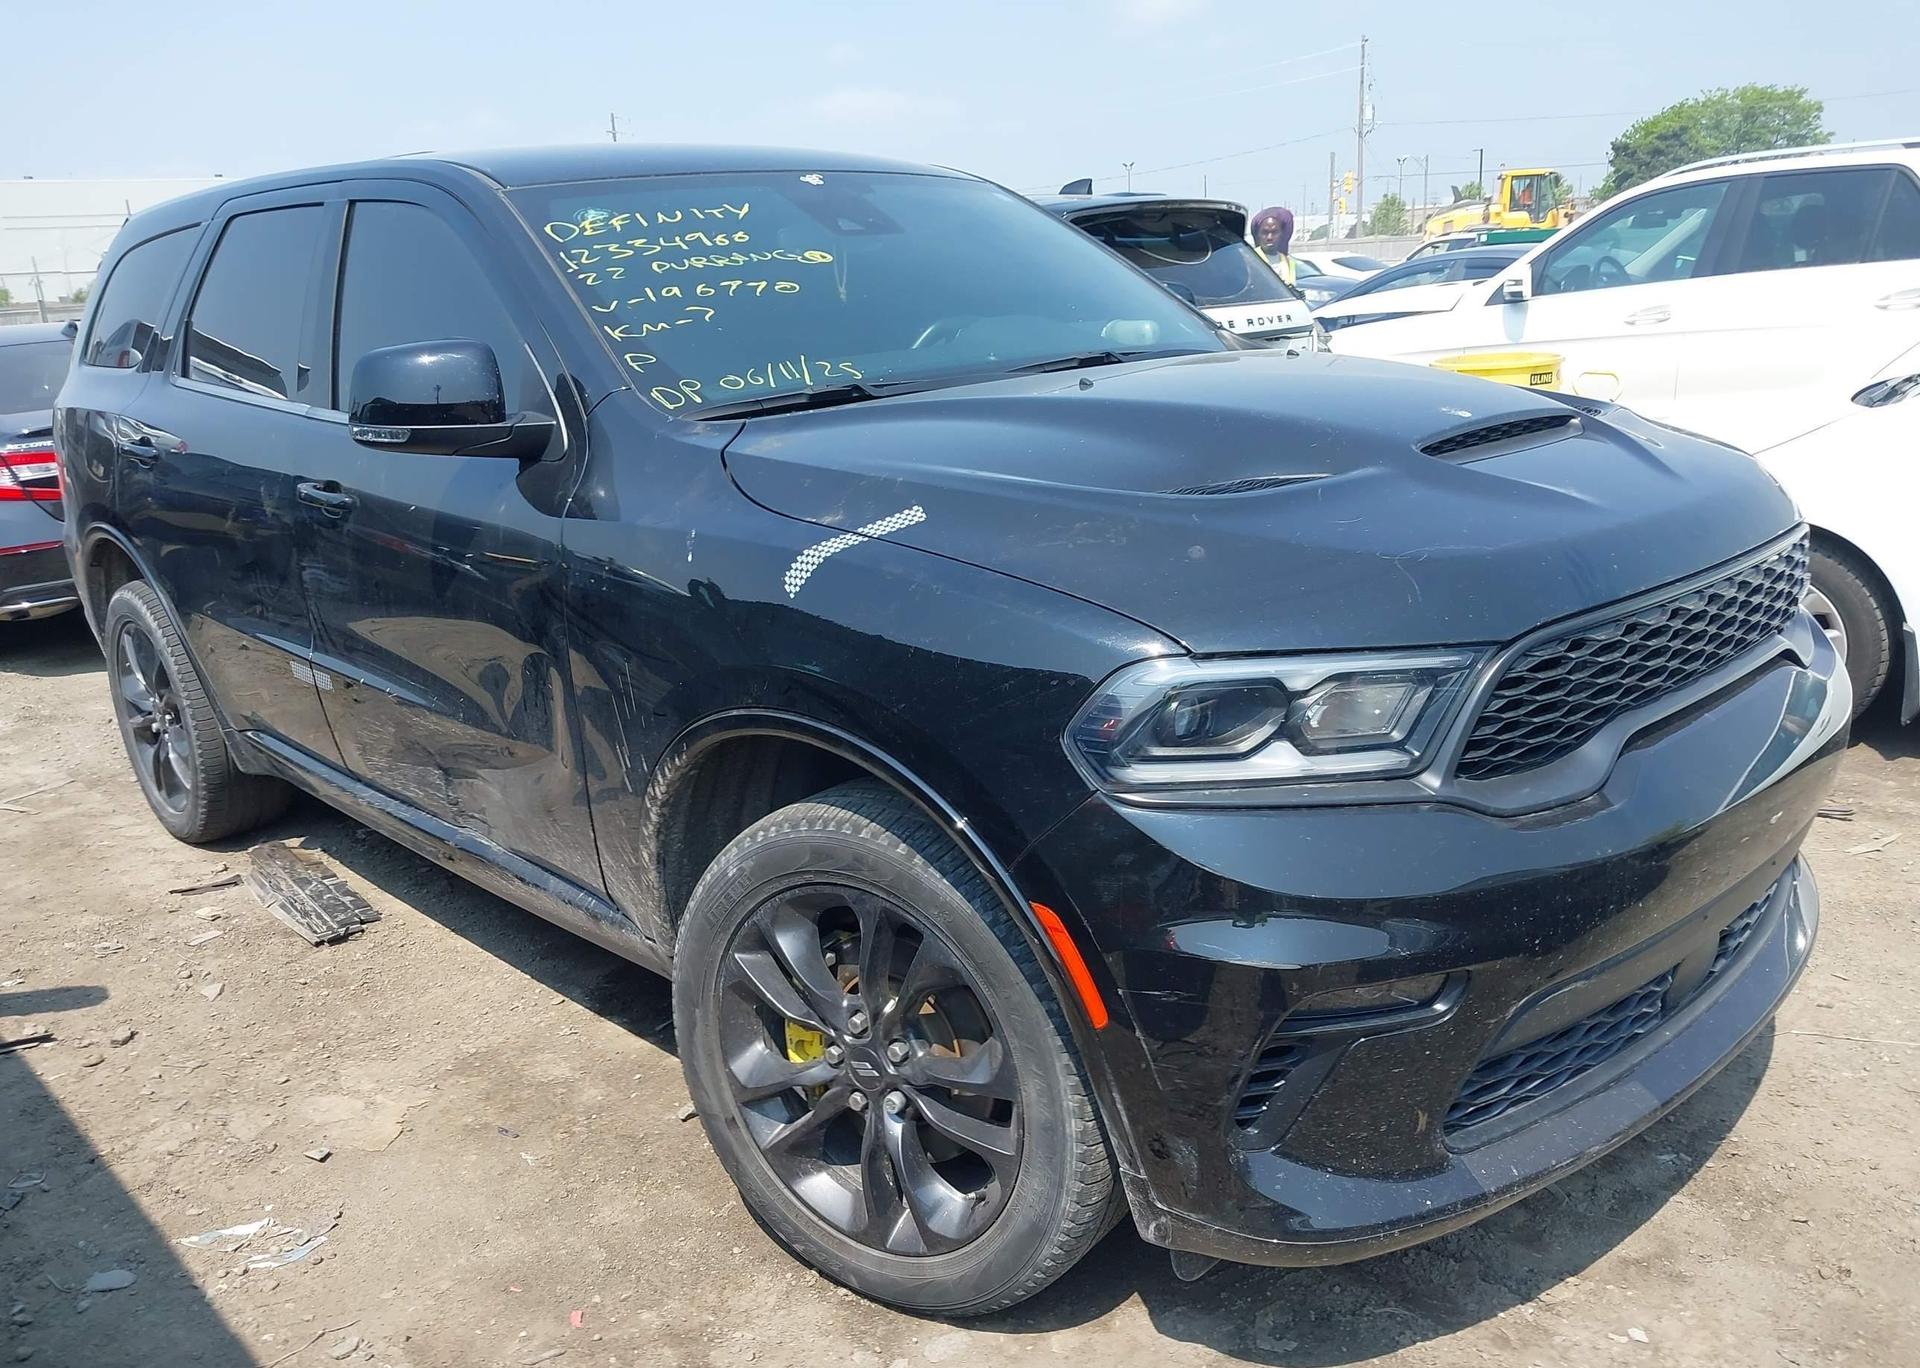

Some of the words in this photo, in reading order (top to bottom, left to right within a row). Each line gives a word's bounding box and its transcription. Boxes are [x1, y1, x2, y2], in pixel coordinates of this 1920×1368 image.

[543, 202, 750, 243] DEFINITY
[577, 267, 626, 286] 22
[1246, 314, 1293, 327] ROVER
[624, 353, 658, 373] P
[650, 379, 703, 410] DP
[719, 355, 864, 390] 06/11/25
[1531, 373, 1553, 384] ULINE
